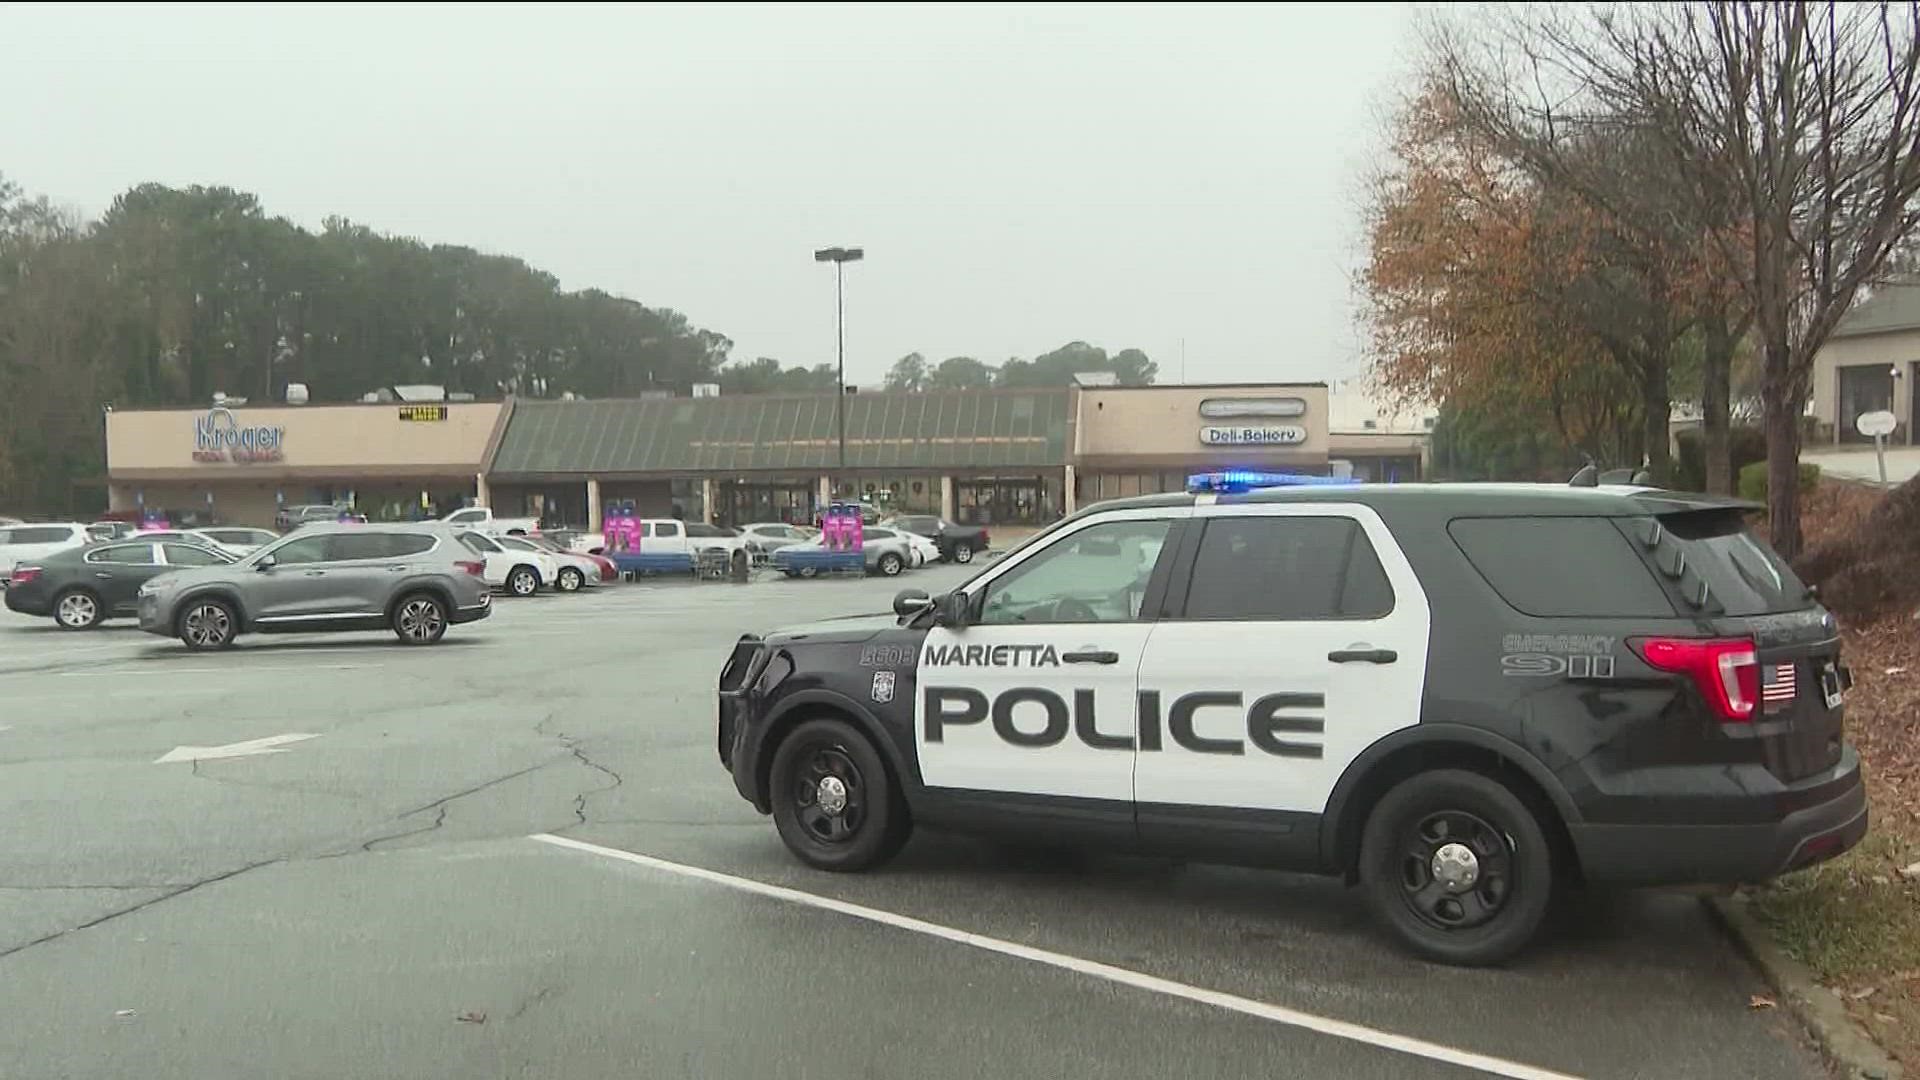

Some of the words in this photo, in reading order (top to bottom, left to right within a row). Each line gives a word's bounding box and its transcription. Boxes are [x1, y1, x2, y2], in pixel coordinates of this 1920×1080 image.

[196, 408, 284, 453] Kroger
[924, 645, 1059, 667] MARIETTA
[1502, 654, 1615, 678] 911
[923, 686, 1326, 759] POLICE
